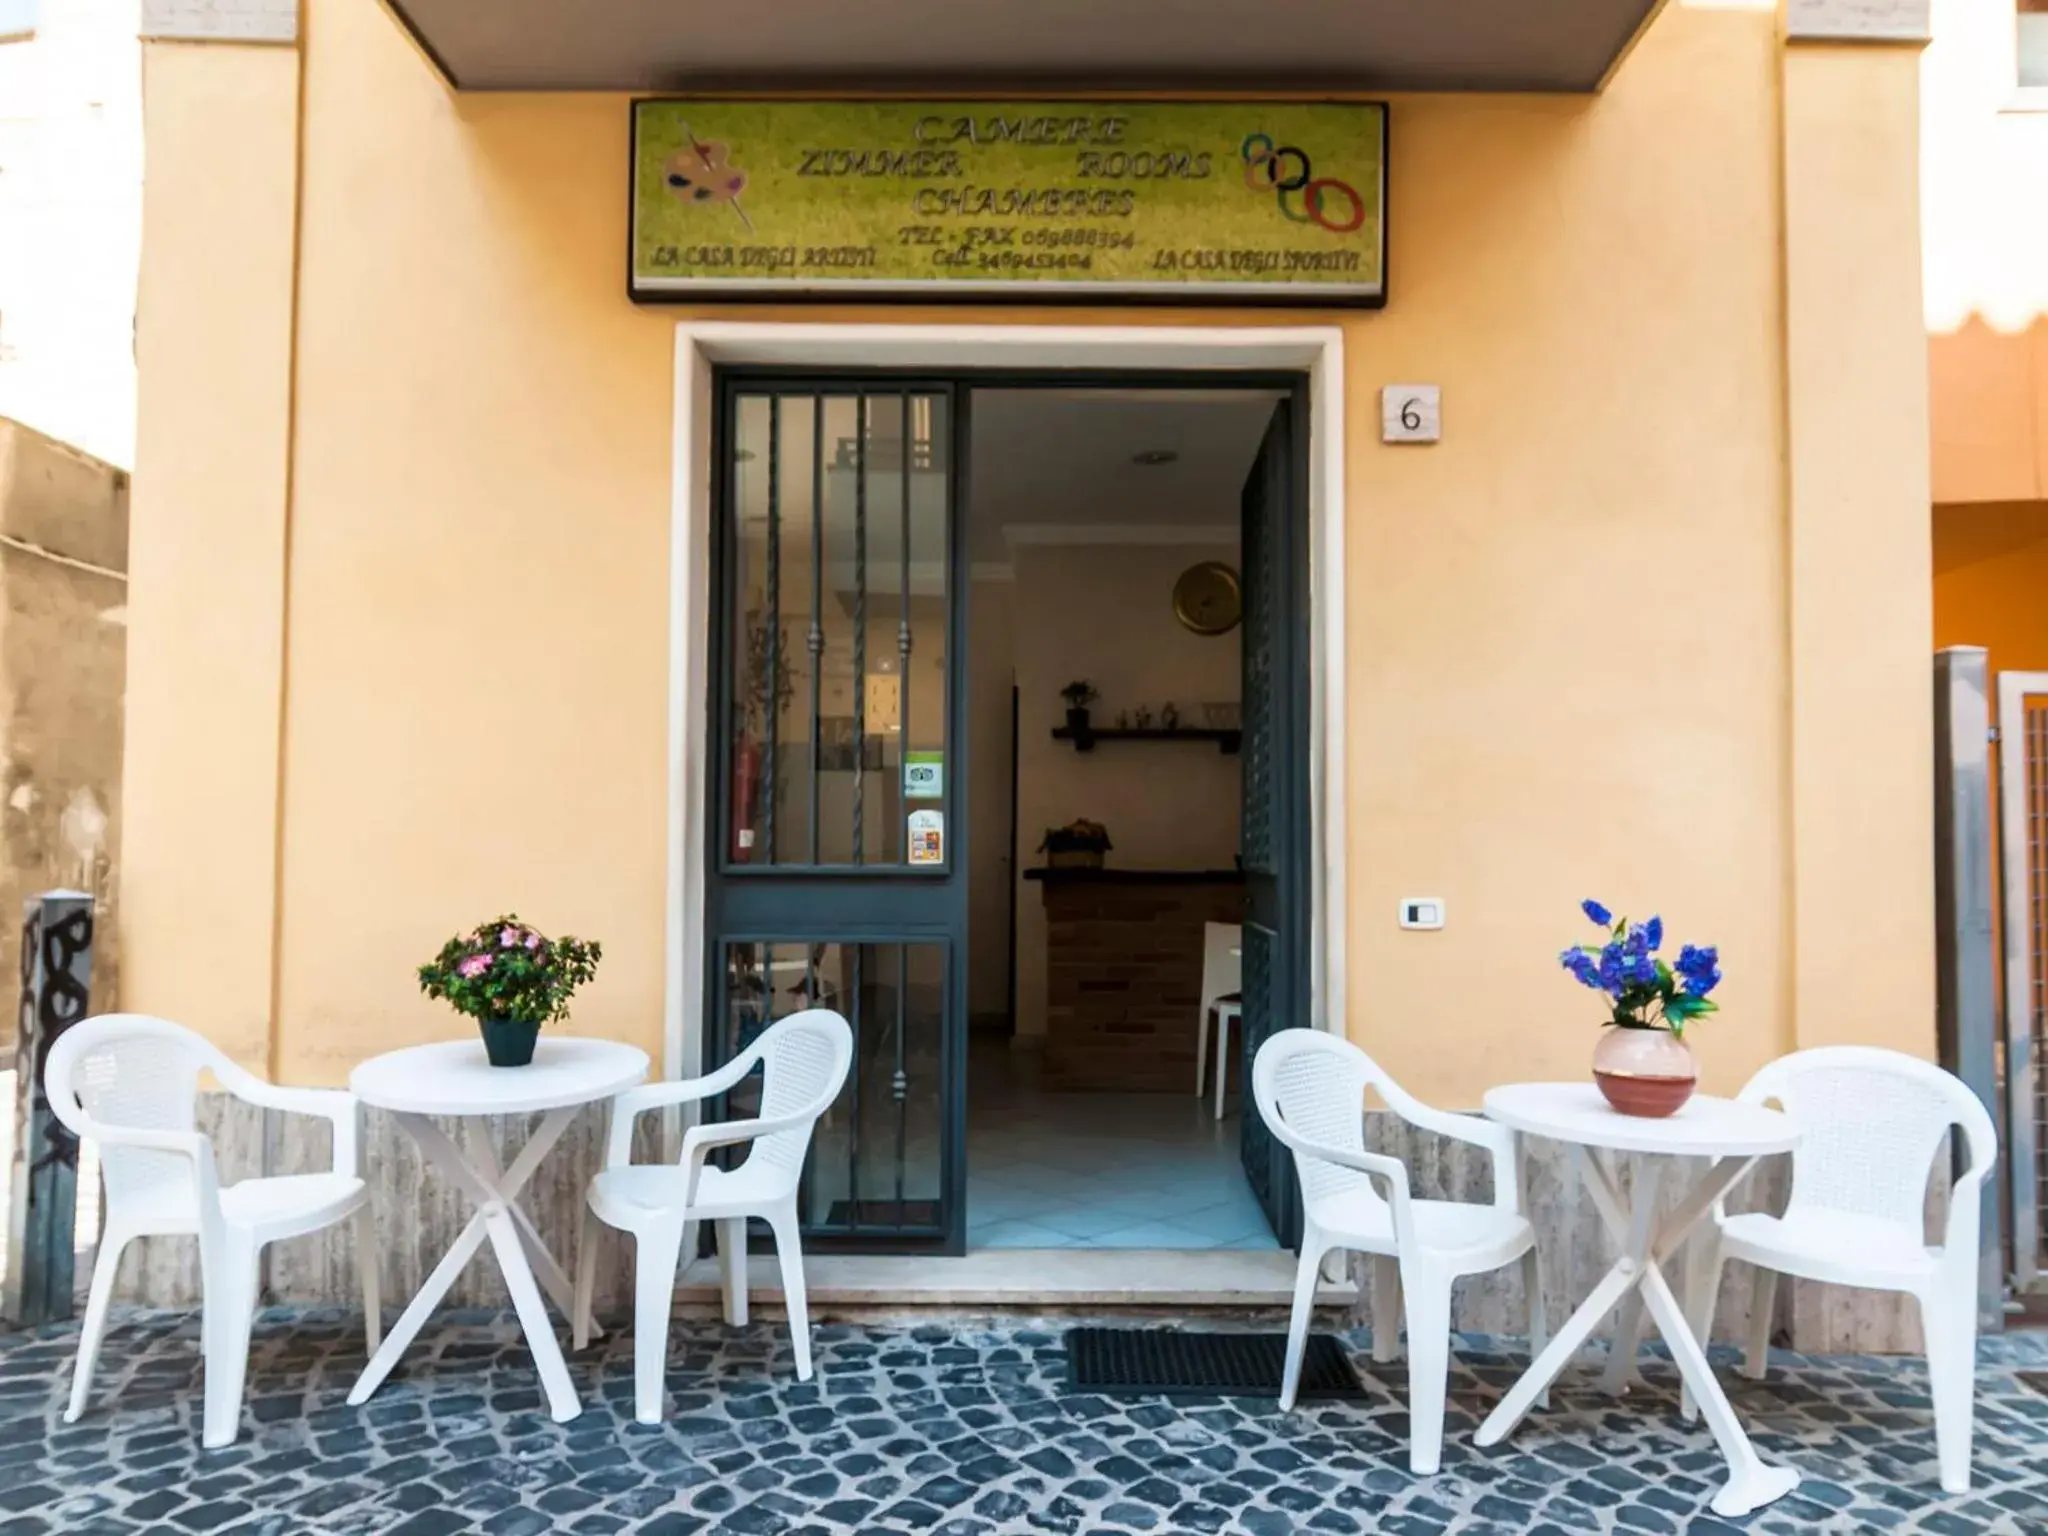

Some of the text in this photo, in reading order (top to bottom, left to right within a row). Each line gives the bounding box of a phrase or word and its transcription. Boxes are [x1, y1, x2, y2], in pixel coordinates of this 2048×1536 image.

[913, 115, 1129, 145] CAMERE
[796, 149, 965, 177] ZIMMER
[1075, 150, 1213, 179] ROOMS
[914, 186, 1136, 217] CHAMBRES
[898, 226, 943, 245] TEL
[963, 226, 1018, 246] FAX
[652, 246, 679, 267] LA
[686, 246, 734, 267] CASA
[1152, 249, 1178, 271] LA
[1180, 248, 1225, 271] CASA
[1401, 397, 1422, 431] 6
